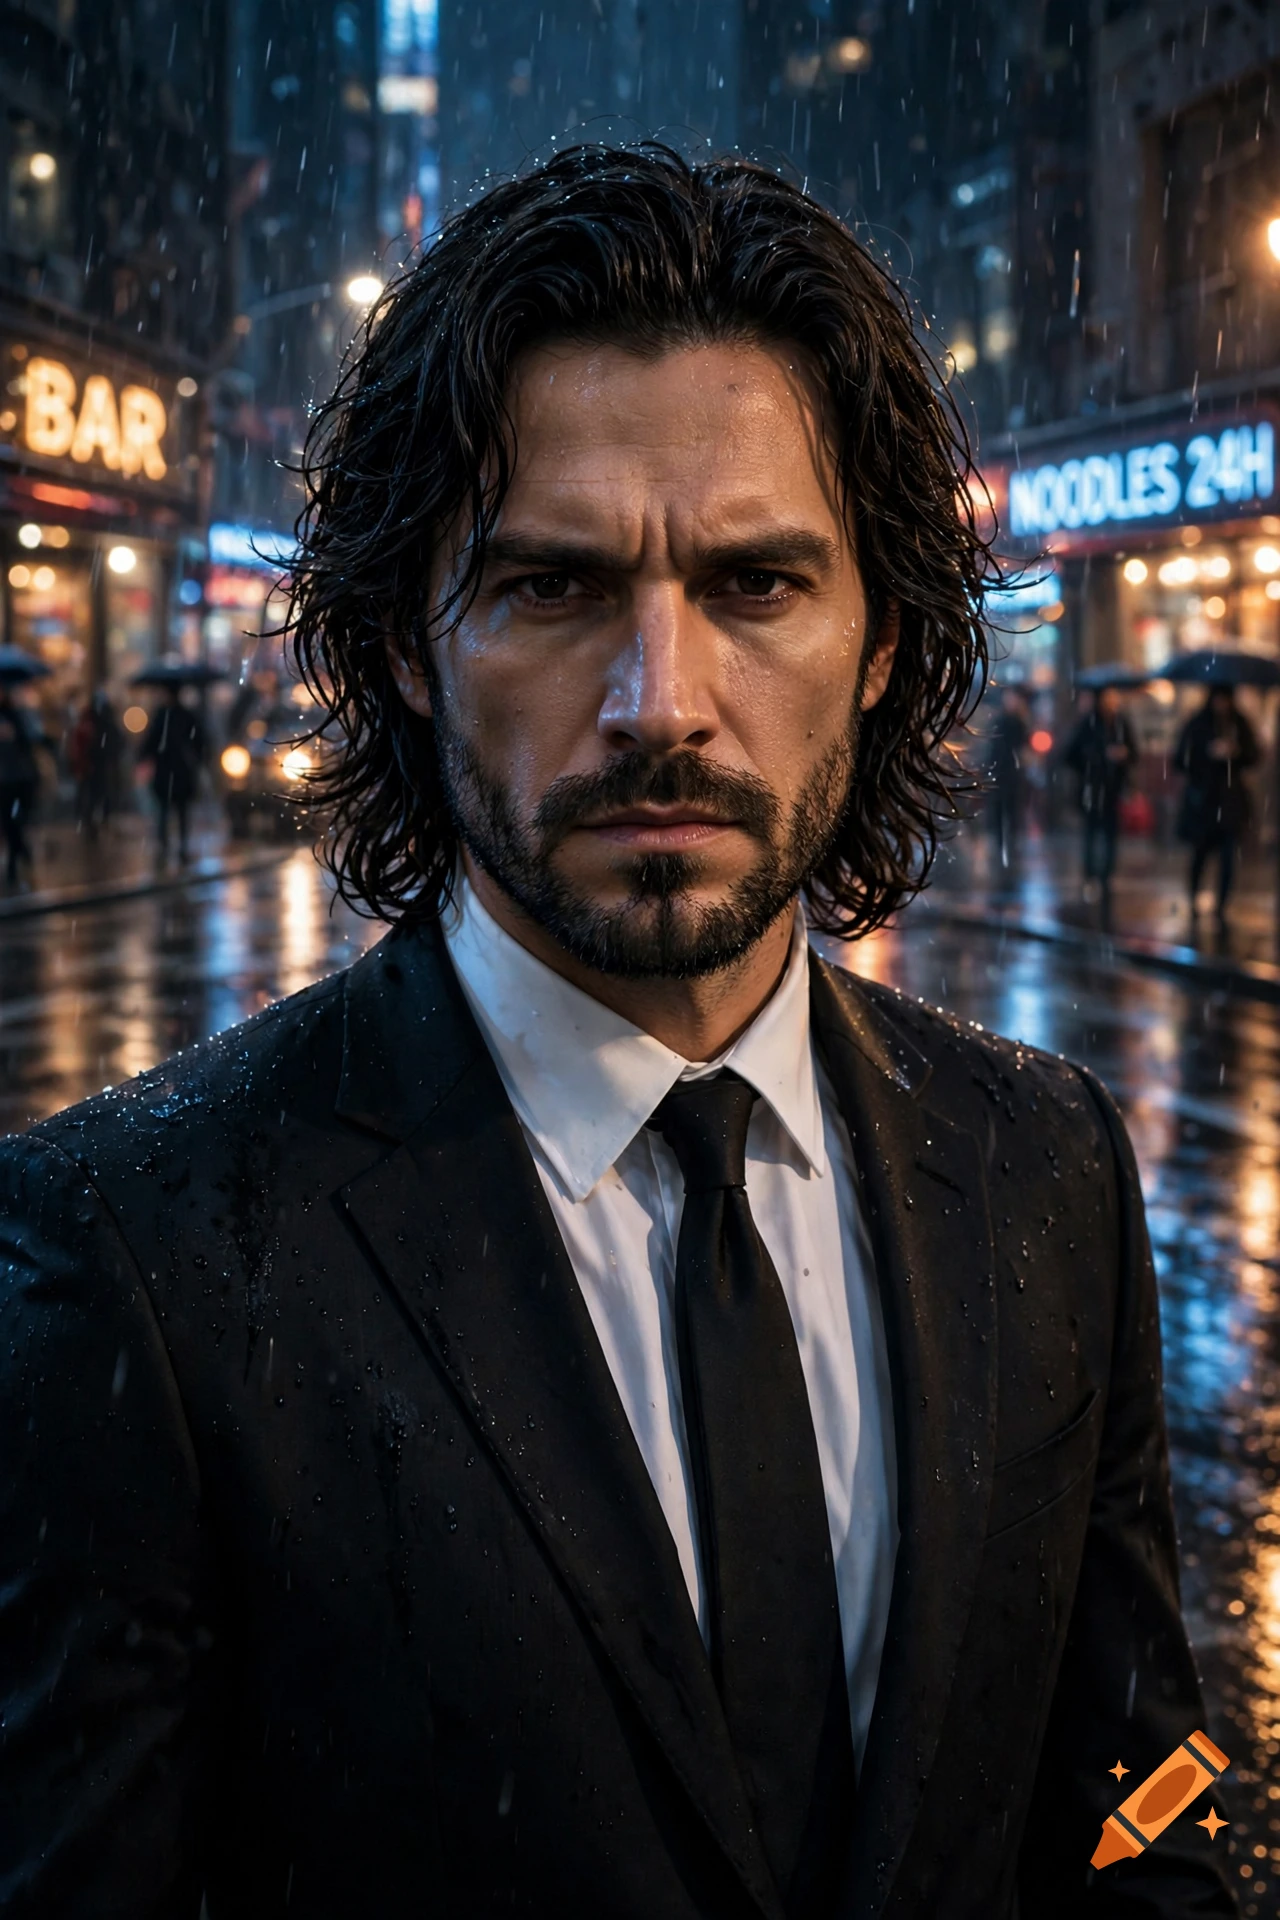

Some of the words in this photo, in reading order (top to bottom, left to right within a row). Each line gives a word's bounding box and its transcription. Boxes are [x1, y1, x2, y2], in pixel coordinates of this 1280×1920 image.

[25, 358, 167, 480] BAR
[1010, 443, 1180, 536] NOODLES
[1186, 422, 1274, 508] 24H
